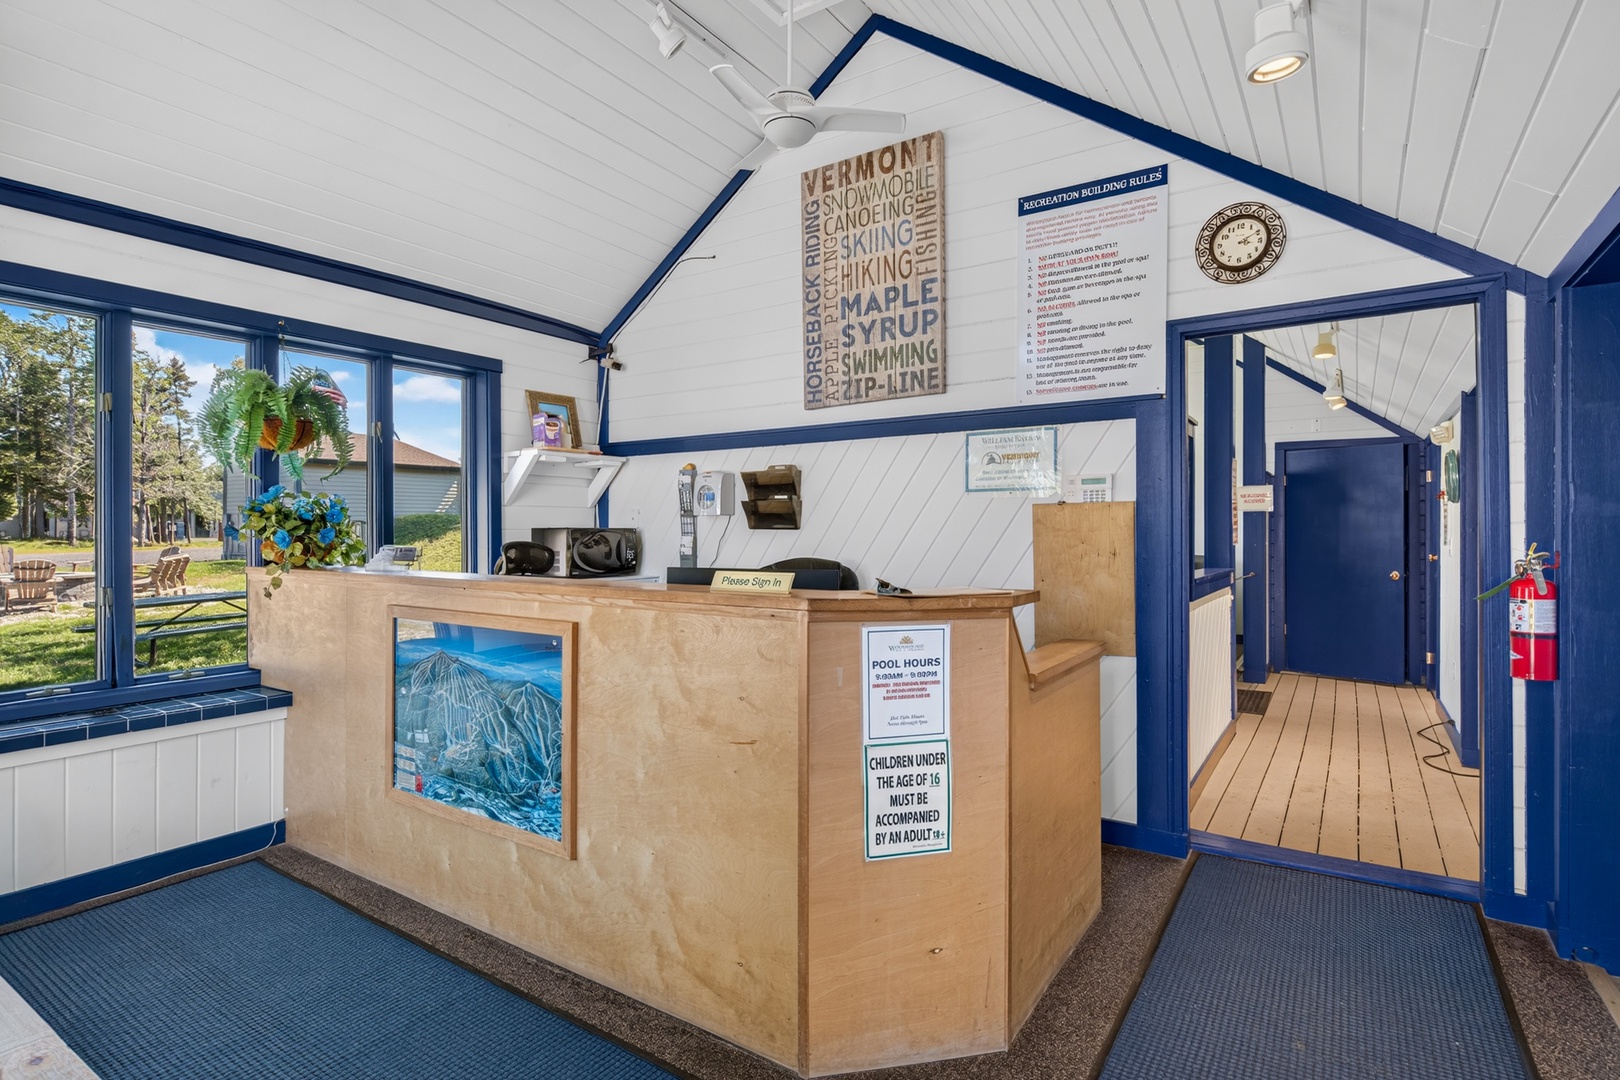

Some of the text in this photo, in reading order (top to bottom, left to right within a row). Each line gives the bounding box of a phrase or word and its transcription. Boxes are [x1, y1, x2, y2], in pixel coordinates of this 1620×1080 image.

[804, 134, 937, 196] VERMONT
[823, 166, 934, 216] SNOWMOBILE
[1023, 171, 1161, 210] RECREATION BUILDING RULES
[824, 196, 914, 236] CANOEING
[916, 190, 938, 276] FISHING
[841, 218, 913, 261] SKIING
[842, 250, 913, 292] HIKING
[804, 200, 822, 404] HORSEBACK RIDING
[841, 277, 938, 320] MAPLE
[824, 236, 839, 401] APPLE PICKING
[842, 308, 938, 348] SYRUP
[842, 339, 938, 377] SWIMMING
[843, 367, 939, 400] ZIP-LINE
[721, 576, 782, 588] Please Sign In
[872, 658, 940, 669] POOL HOURS
[870, 752, 946, 770] CHILDREN UNDER
[877, 772, 940, 789] THE AGE OF 16
[875, 810, 940, 827] ACCOMPANIED
[890, 792, 928, 807] MUST BE
[876, 832, 887, 845] BY
[888, 830, 901, 844] AN
[903, 828, 932, 842] ADULT
